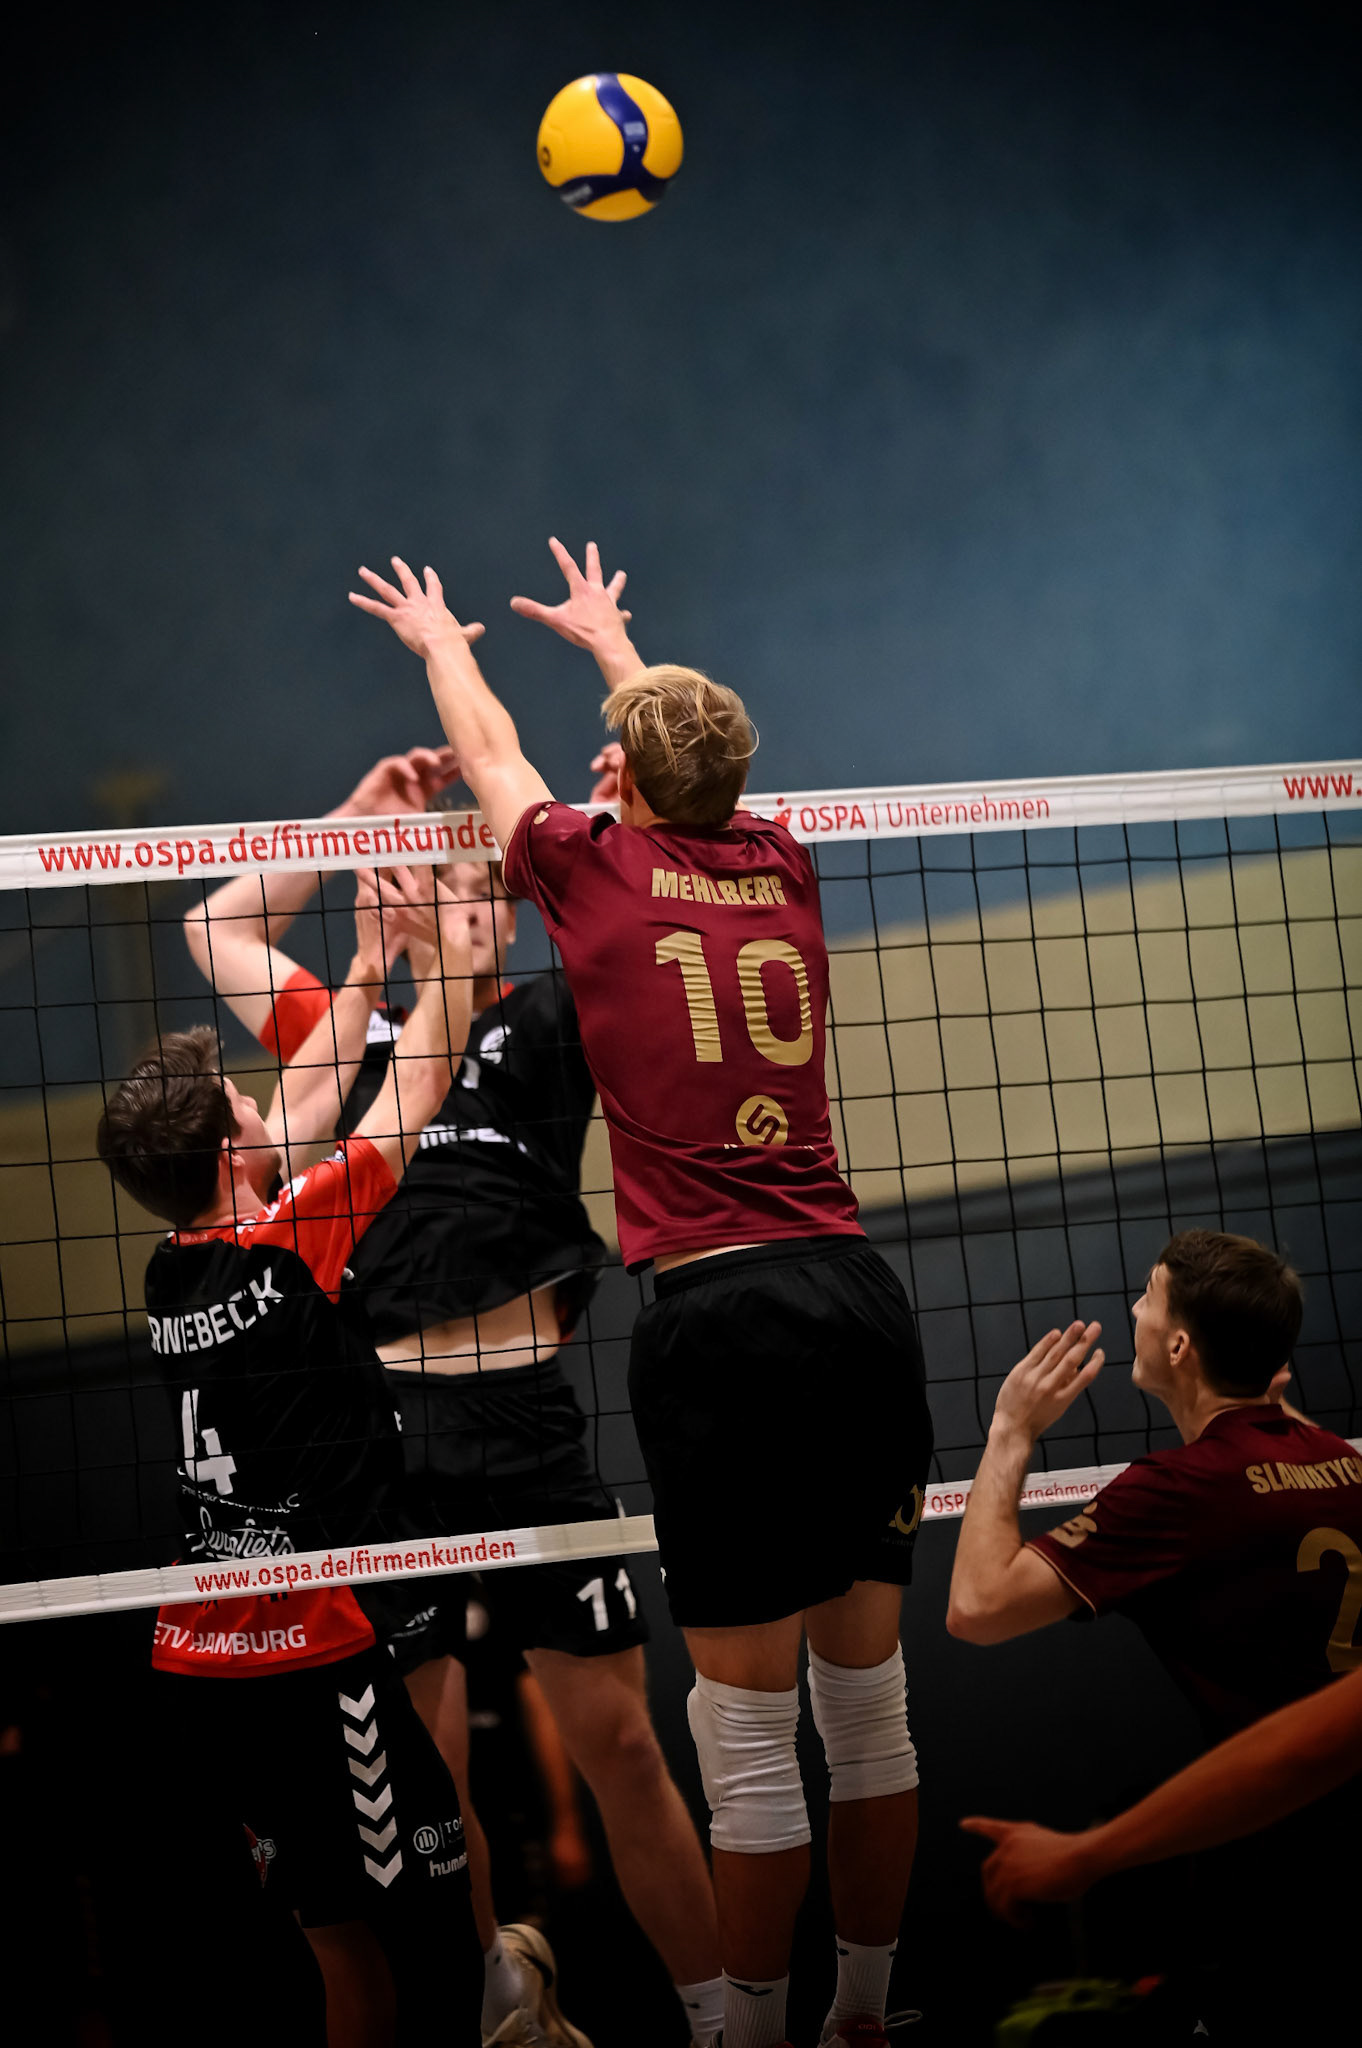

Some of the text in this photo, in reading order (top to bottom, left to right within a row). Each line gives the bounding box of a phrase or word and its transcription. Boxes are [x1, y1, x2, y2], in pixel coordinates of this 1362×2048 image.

[1283, 774, 1362, 799] www.
[800, 793, 1050, 833] OSPA Unternehmen
[38, 814, 496, 875] www.ospa.de/firmenkunde
[652, 868, 788, 905] MEHLBERG
[655, 931, 814, 1066] 10
[182, 1388, 237, 1496] 4
[1021, 1482, 1099, 1503] ernehmen
[194, 1537, 516, 1589] www.ospa.de/firmenkunden
[576, 1568, 636, 1632] 11
[187, 1624, 307, 1656] HAMBURG
